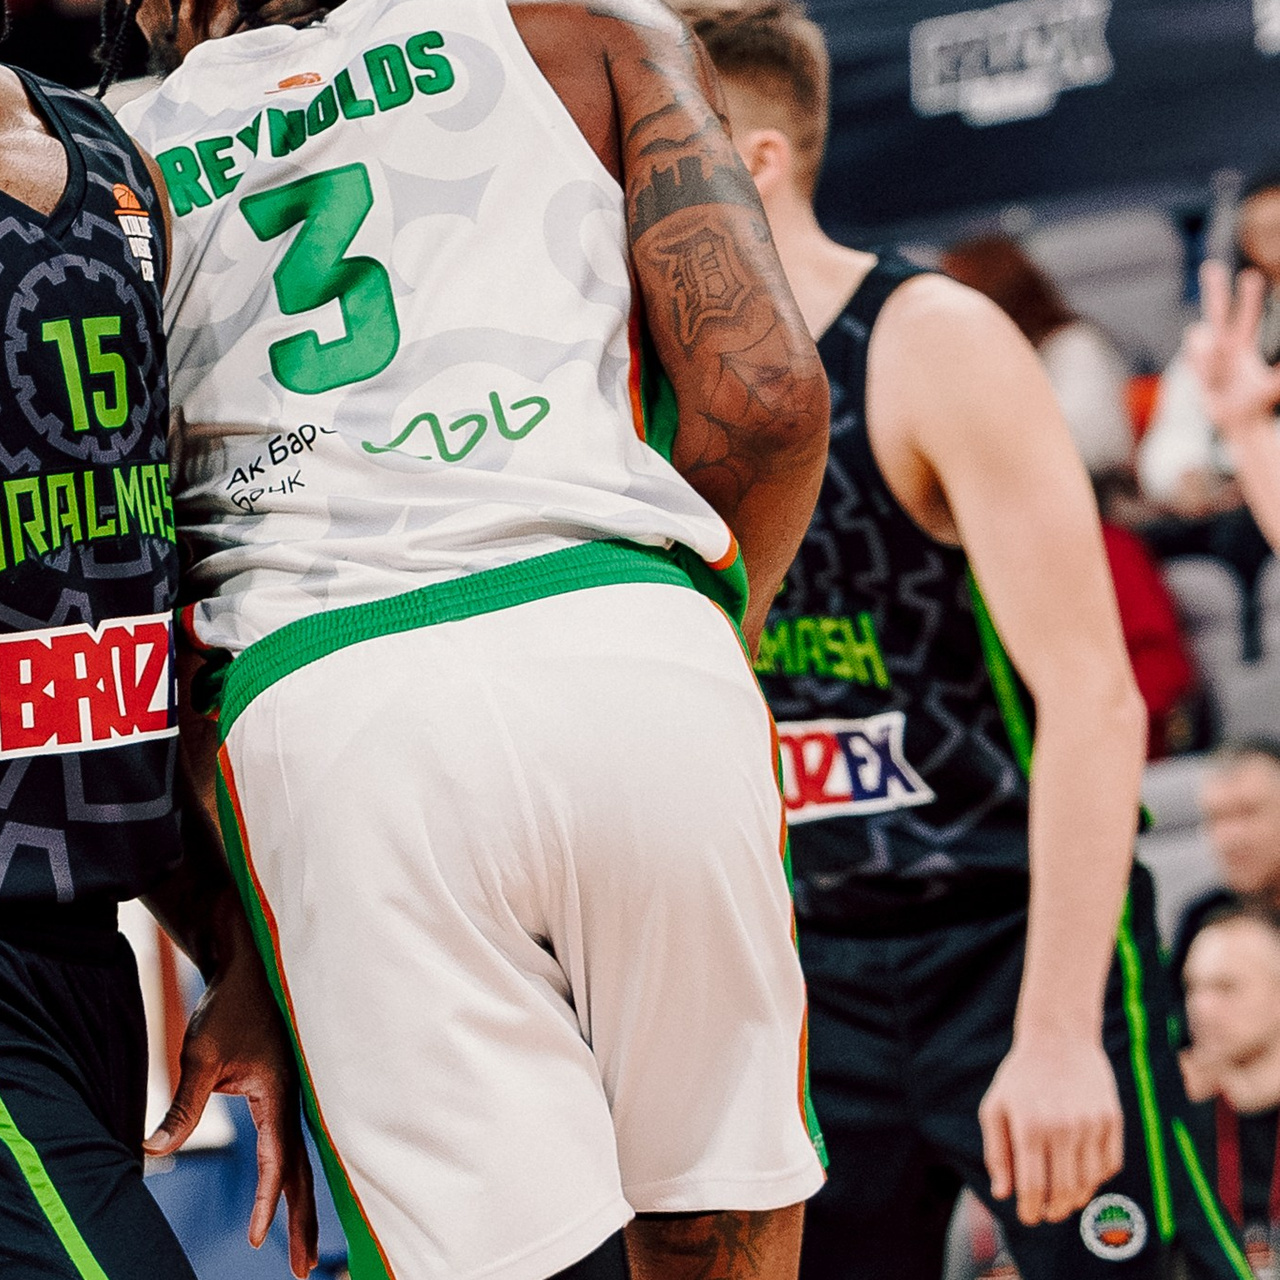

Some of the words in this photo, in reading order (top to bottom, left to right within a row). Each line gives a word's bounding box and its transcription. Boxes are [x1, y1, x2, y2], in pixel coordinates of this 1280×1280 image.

[156, 30, 455, 218] REYNOLDS
[239, 161, 401, 396] 3
[42, 316, 129, 432] 15
[753, 610, 892, 690] MASH
